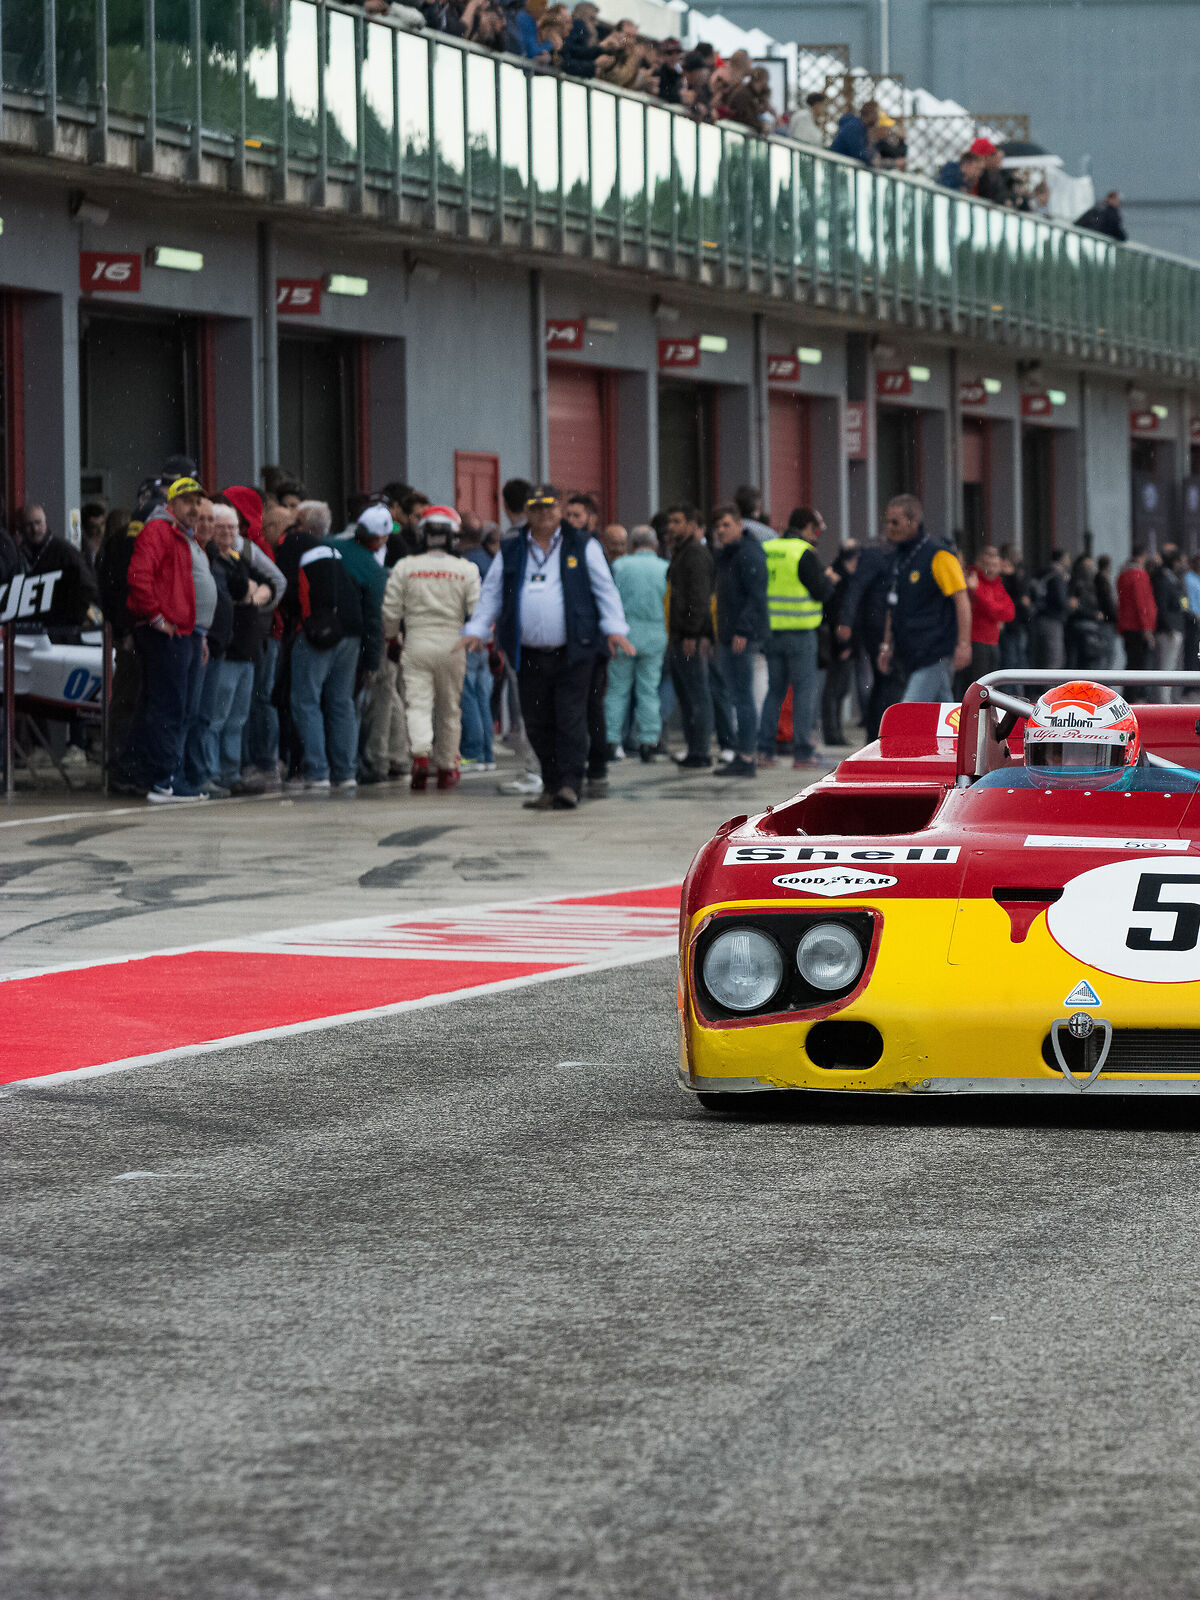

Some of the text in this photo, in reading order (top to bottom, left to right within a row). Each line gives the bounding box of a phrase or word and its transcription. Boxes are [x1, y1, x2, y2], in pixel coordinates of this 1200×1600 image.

[90, 261, 133, 282] 16
[277, 286, 313, 306] 15
[1049, 712, 1093, 728] Marlboro
[1033, 728, 1112, 742] Alfa Romeo
[735, 847, 951, 862] Shell
